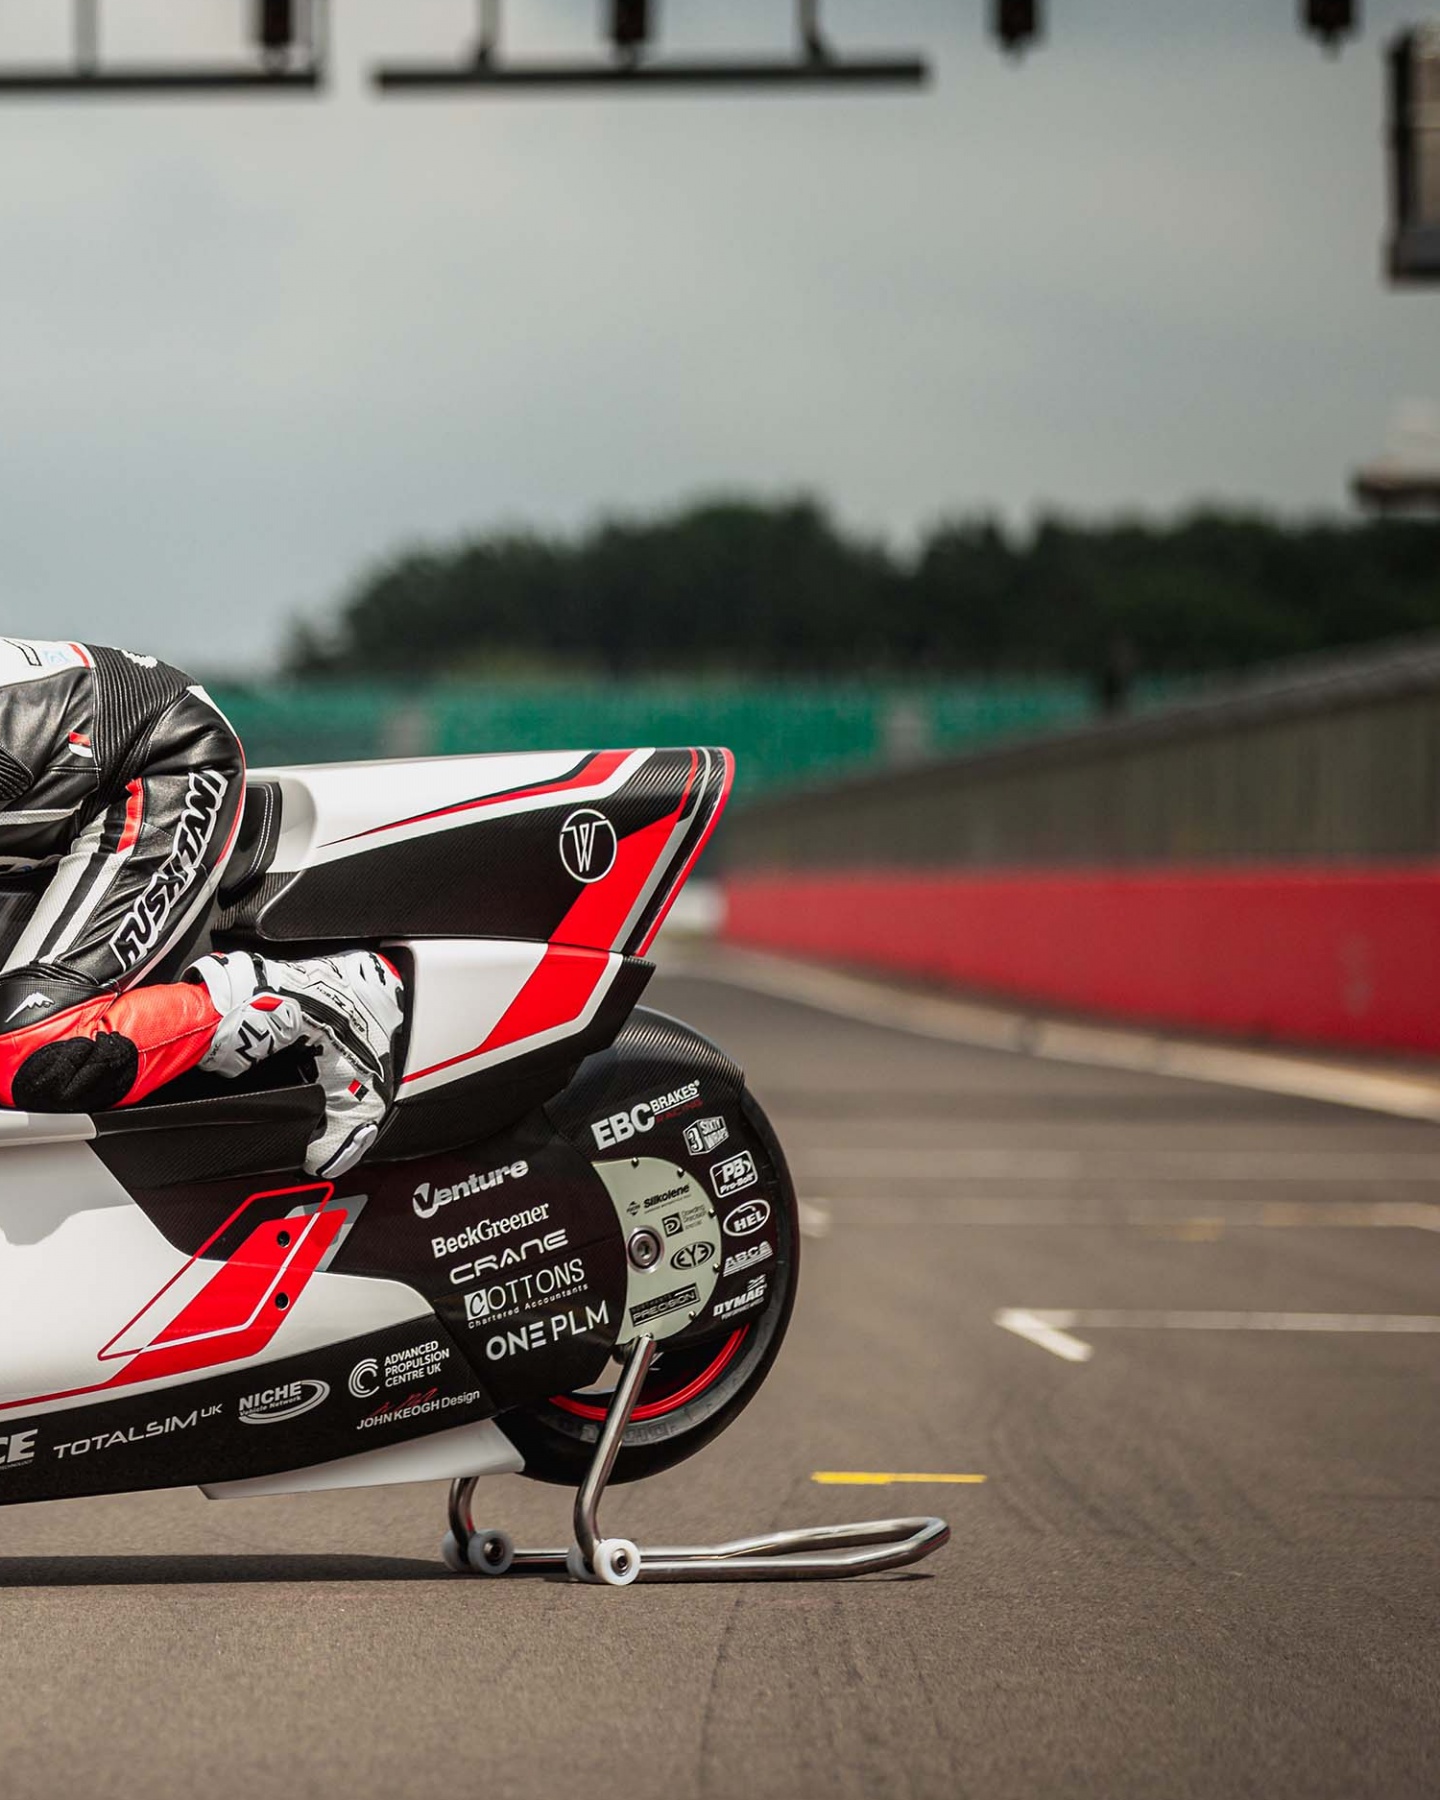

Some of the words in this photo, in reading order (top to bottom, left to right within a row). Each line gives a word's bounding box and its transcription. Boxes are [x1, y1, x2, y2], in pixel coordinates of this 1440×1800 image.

[110, 769, 228, 972] KUSHITANI
[591, 1102, 656, 1151] EBC
[412, 1160, 529, 1219] Venture
[431, 1203, 549, 1259] BeckGreener
[733, 1210, 766, 1233] HEL
[449, 1228, 569, 1285] CRANE
[463, 1258, 585, 1321] COTTONS
[468, 1307, 520, 1329] Chartered
[524, 1283, 589, 1310] Accountants
[713, 1286, 766, 1317] DYMAG
[384, 1340, 439, 1366] ADVANCED
[485, 1321, 547, 1361] ONE
[551, 1300, 610, 1341] PLM
[385, 1348, 450, 1377] PROPULSION
[385, 1368, 426, 1388] CENTRE
[426, 1362, 442, 1375] UK
[238, 1381, 302, 1411] NICHE
[356, 1410, 393, 1430] JOHN
[393, 1400, 440, 1421] KEOGH
[441, 1389, 480, 1409] Design
[53, 1410, 199, 1459] TOTALSIM
